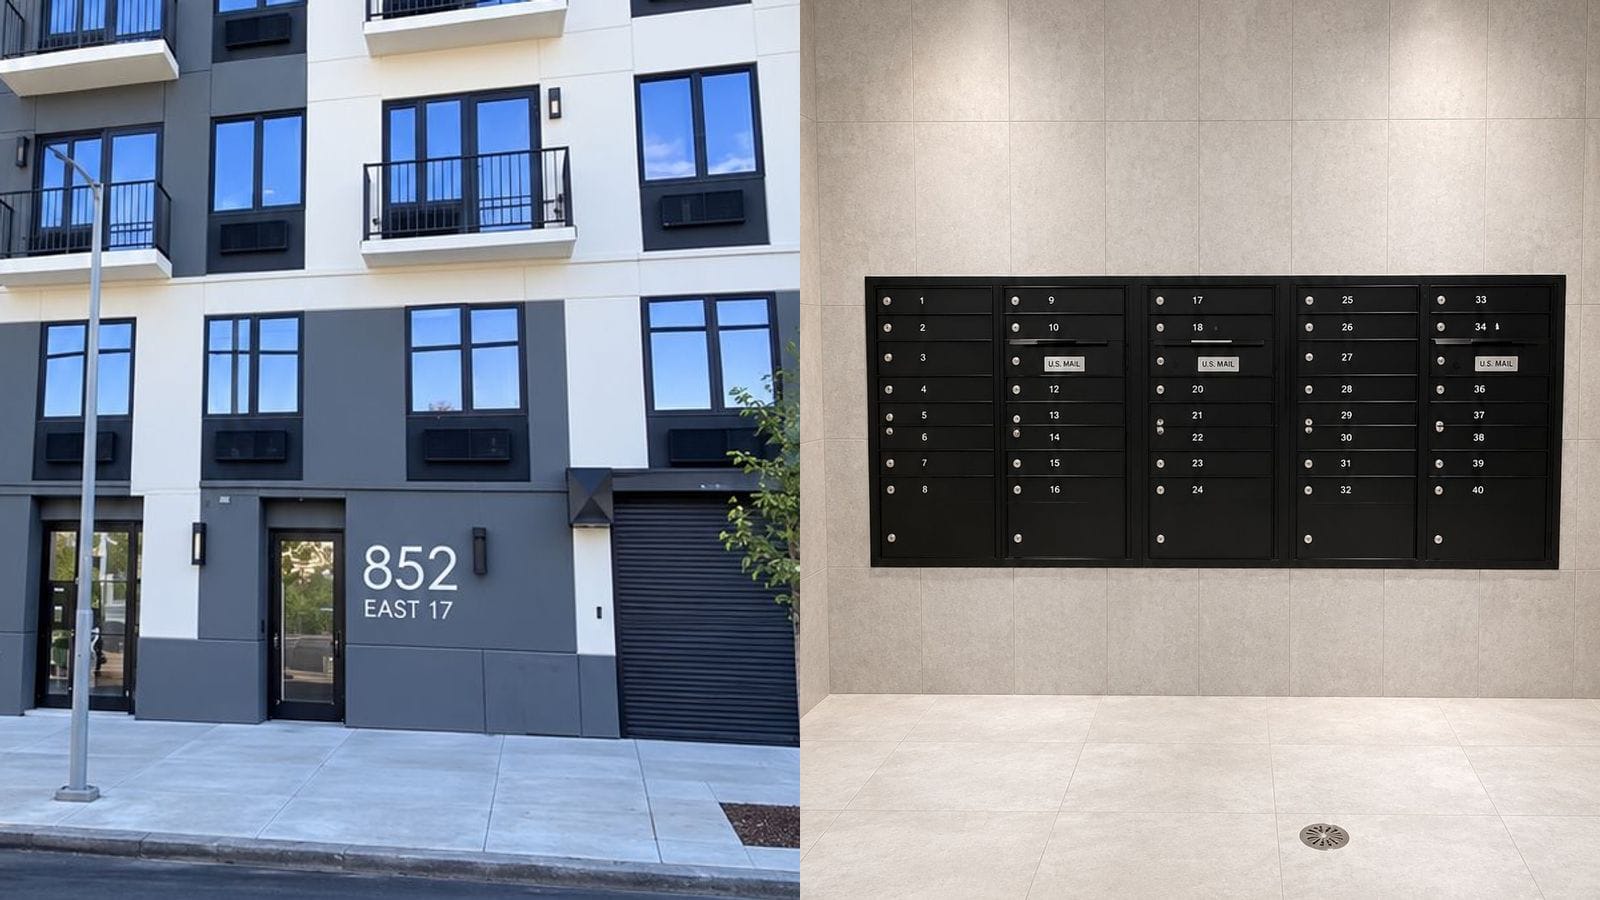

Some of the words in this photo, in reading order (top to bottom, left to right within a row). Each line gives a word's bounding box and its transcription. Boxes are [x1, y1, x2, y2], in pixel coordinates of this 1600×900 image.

[919, 296, 924, 305] 1
[1048, 295, 1055, 305] 9
[1192, 295, 1204, 305] 17
[1341, 295, 1354, 305] 25
[1475, 295, 1487, 304] 33
[919, 323, 926, 332] 2
[1048, 323, 1060, 332] 10
[1192, 322, 1204, 332] 18
[1341, 322, 1354, 332] 26
[1474, 322, 1487, 332] 34
[920, 353, 927, 362] 3
[1341, 352, 1353, 362] 27
[1063, 360, 1081, 368] MAIL
[1216, 360, 1235, 368] MAIL
[1494, 360, 1513, 368] MAIL
[920, 384, 927, 394] 4
[1048, 384, 1060, 394] 12
[1191, 384, 1204, 394] 20
[1341, 384, 1353, 394] 28
[1473, 384, 1486, 394] 36
[921, 410, 928, 420] 5
[1049, 410, 1060, 420] 13
[1191, 411, 1203, 420] 21
[1340, 410, 1353, 420] 29
[1473, 410, 1485, 420] 37
[921, 432, 928, 442] 6
[1049, 432, 1060, 442] 14
[1192, 432, 1204, 442] 22
[1340, 433, 1353, 442] 30
[1473, 432, 1485, 442] 38
[921, 458, 928, 467] 7
[1049, 458, 1061, 468] 15
[1191, 458, 1204, 468] 23
[1340, 458, 1351, 468] 31
[1472, 459, 1485, 468] 39
[921, 485, 928, 494] 8
[1049, 485, 1061, 494] 16
[1192, 485, 1204, 494] 24
[1340, 485, 1352, 495] 32
[1471, 485, 1484, 495] 40
[364, 545, 458, 591] 852
[364, 599, 420, 619] EAST
[429, 600, 454, 620] 17
